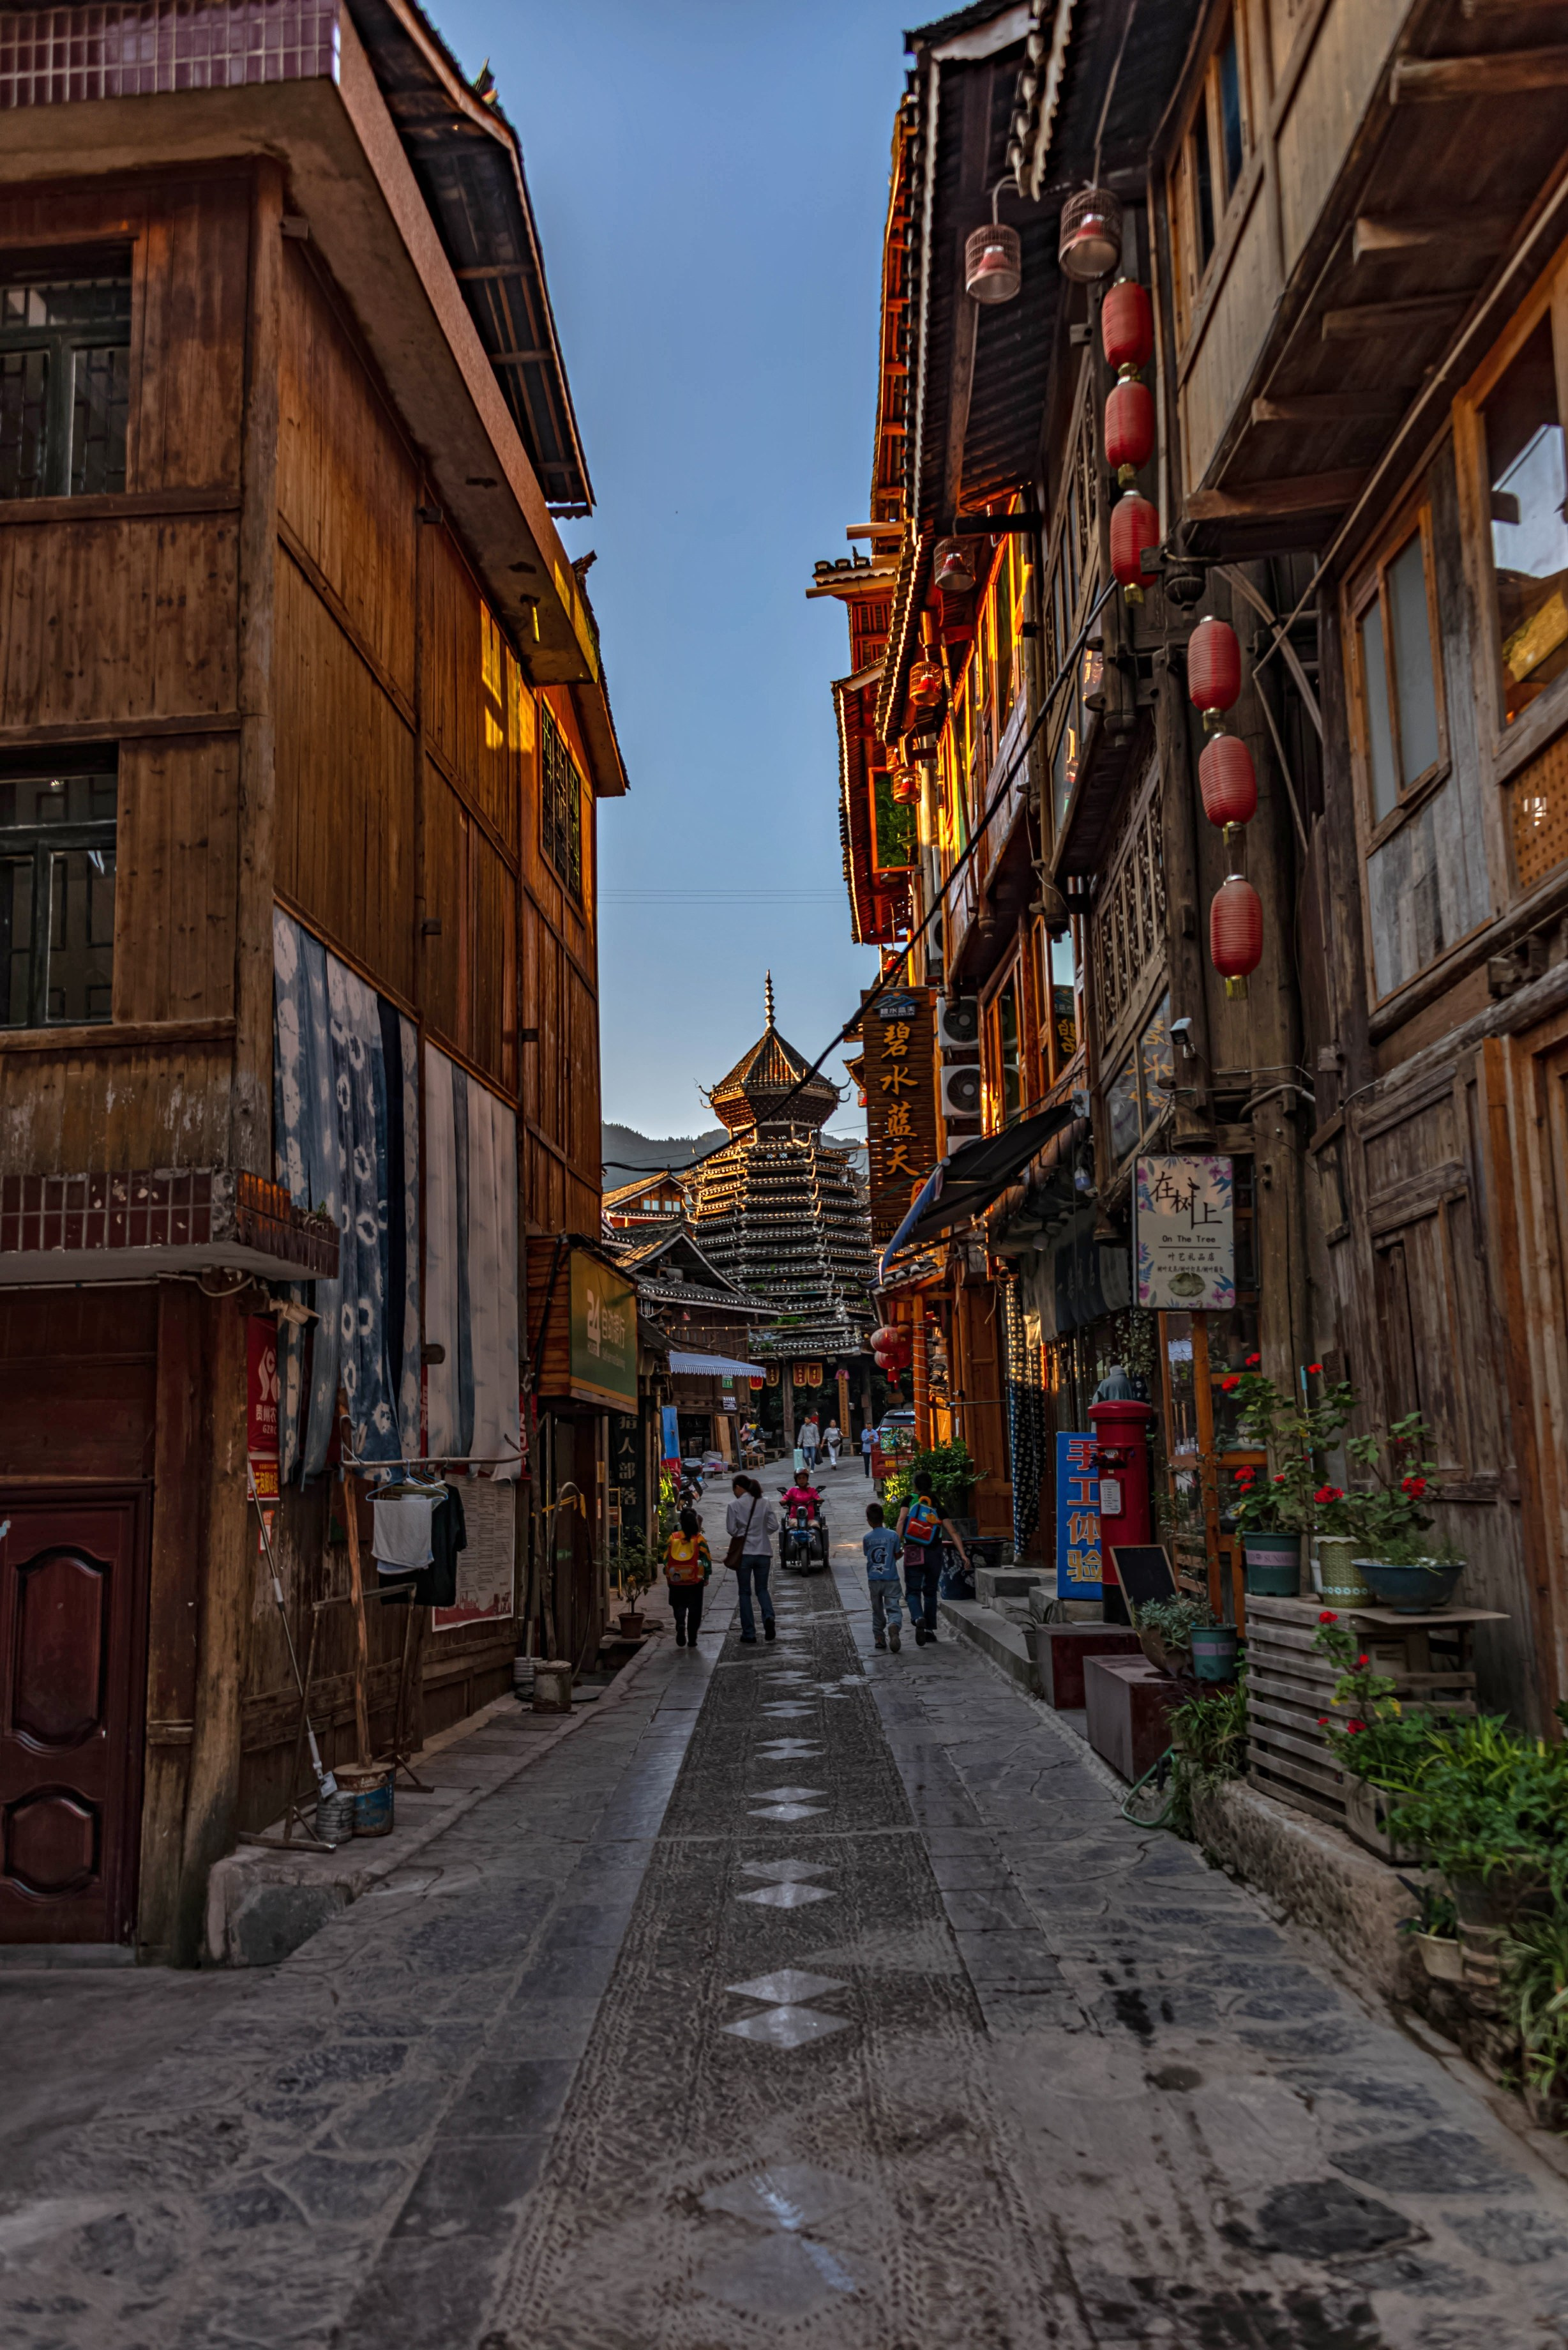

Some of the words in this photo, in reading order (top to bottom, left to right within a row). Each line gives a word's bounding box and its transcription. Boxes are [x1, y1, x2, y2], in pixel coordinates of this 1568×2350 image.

[880, 1021, 919, 1176] 碧水蓝天
[1149, 1171, 1223, 1230] 在树上
[1168, 1252, 1215, 1262] 叶艺礼品店
[587, 1288, 601, 1358] 24
[1066, 1439, 1103, 1583] 手工体验
[870, 1545, 889, 1565] G
